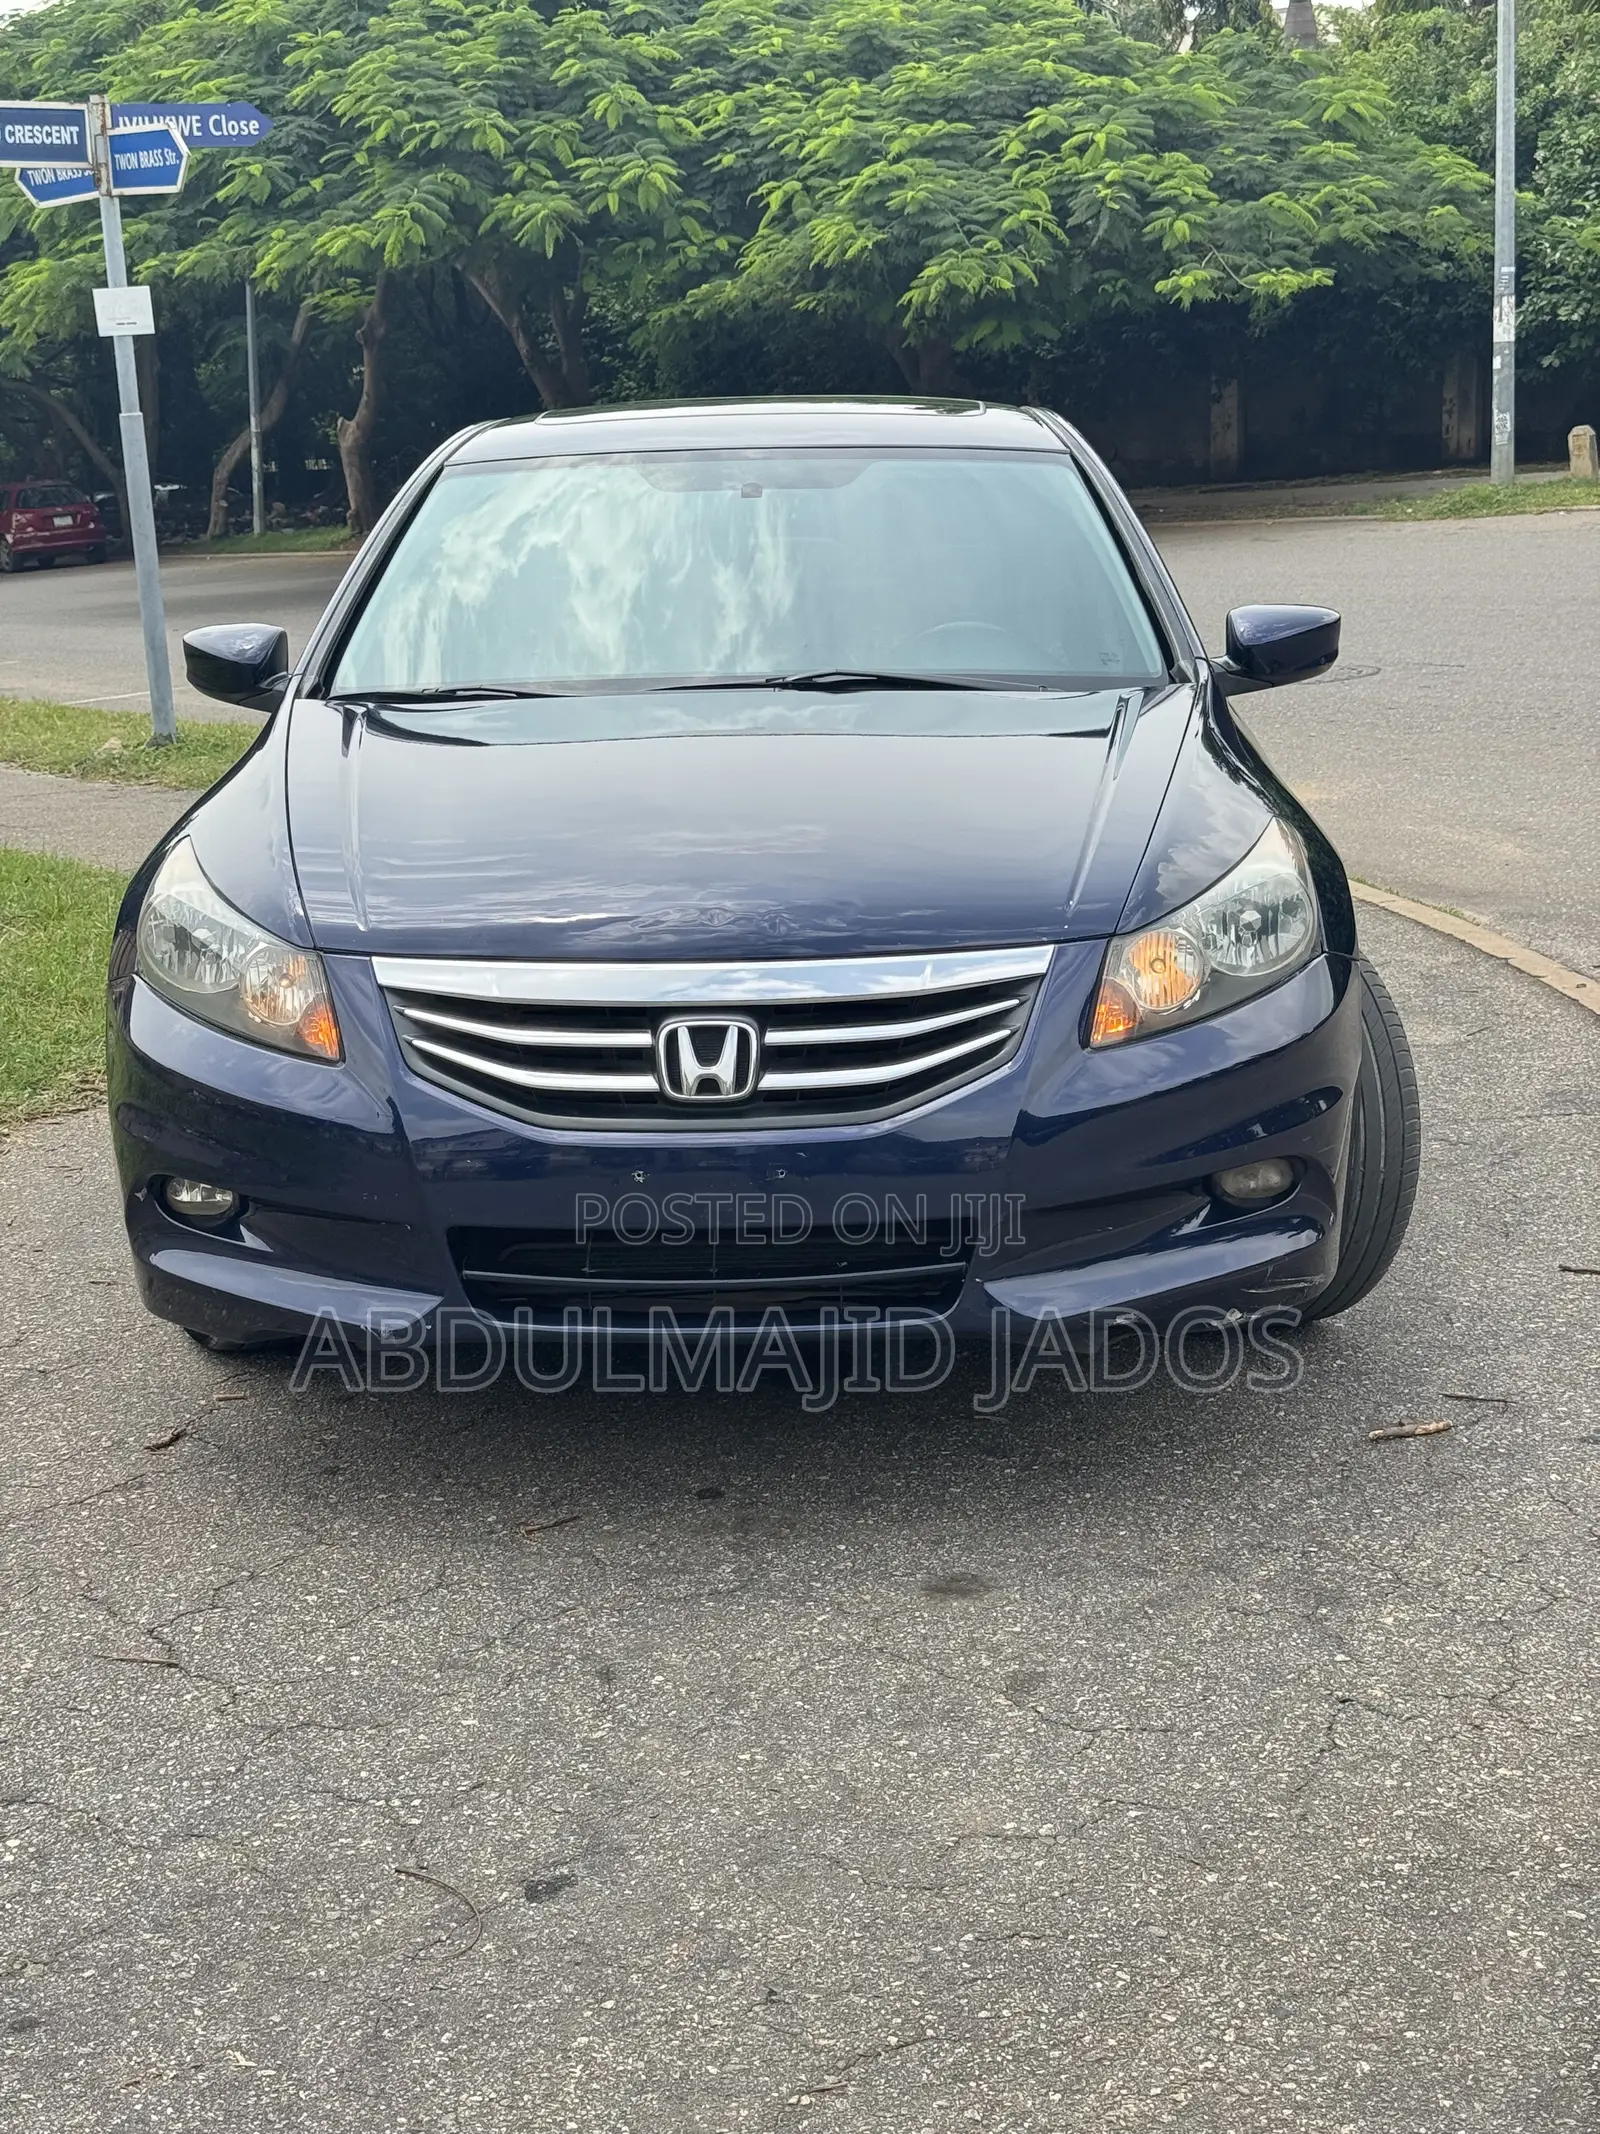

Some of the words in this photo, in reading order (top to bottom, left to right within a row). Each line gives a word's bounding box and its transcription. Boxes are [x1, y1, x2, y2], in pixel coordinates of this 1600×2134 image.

[4, 124, 80, 145] CRESCENT
[208, 114, 260, 136] Close
[113, 152, 139, 171] TWON
[138, 148, 164, 169] BRASS
[27, 168, 56, 187] TWON
